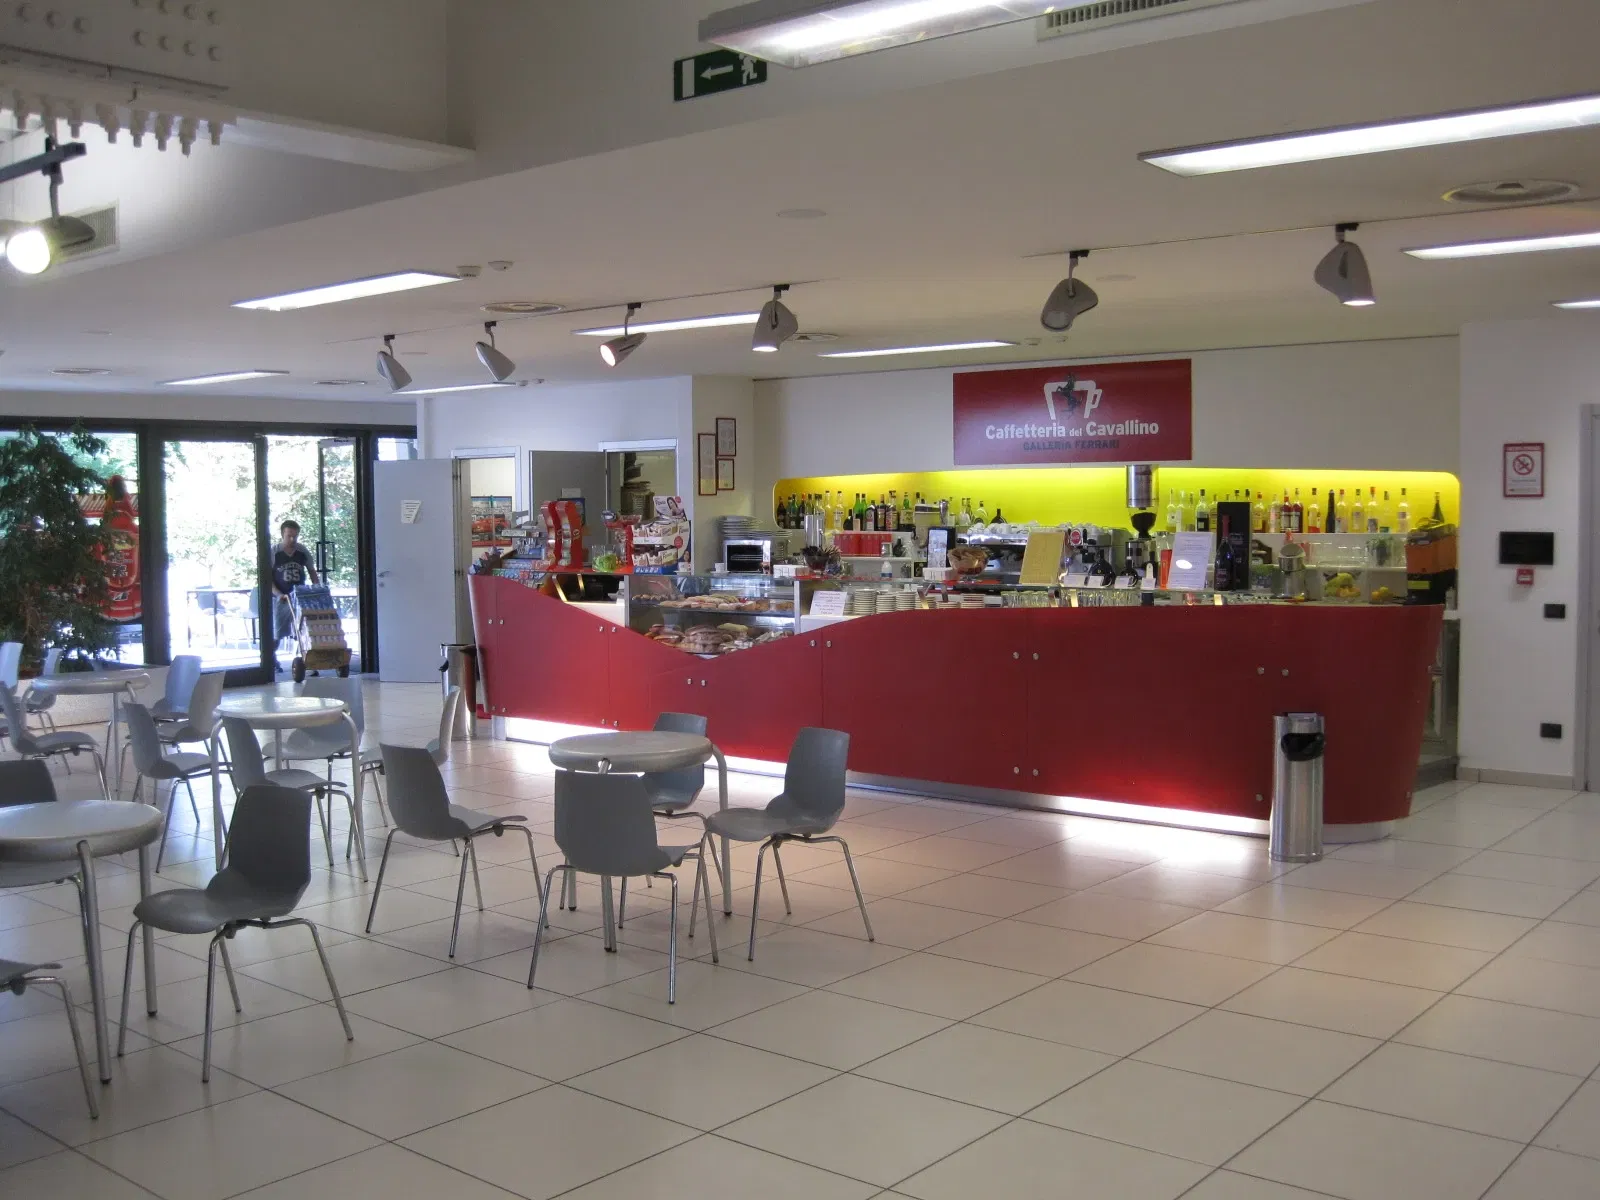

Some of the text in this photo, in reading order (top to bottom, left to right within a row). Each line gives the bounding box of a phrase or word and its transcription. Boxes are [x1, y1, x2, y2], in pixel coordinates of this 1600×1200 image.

[985, 420, 1159, 440] Caffetteria del Cavallino
[1023, 440, 1119, 451] GALLERIA FERRARI
[283, 570, 300, 581] 65
